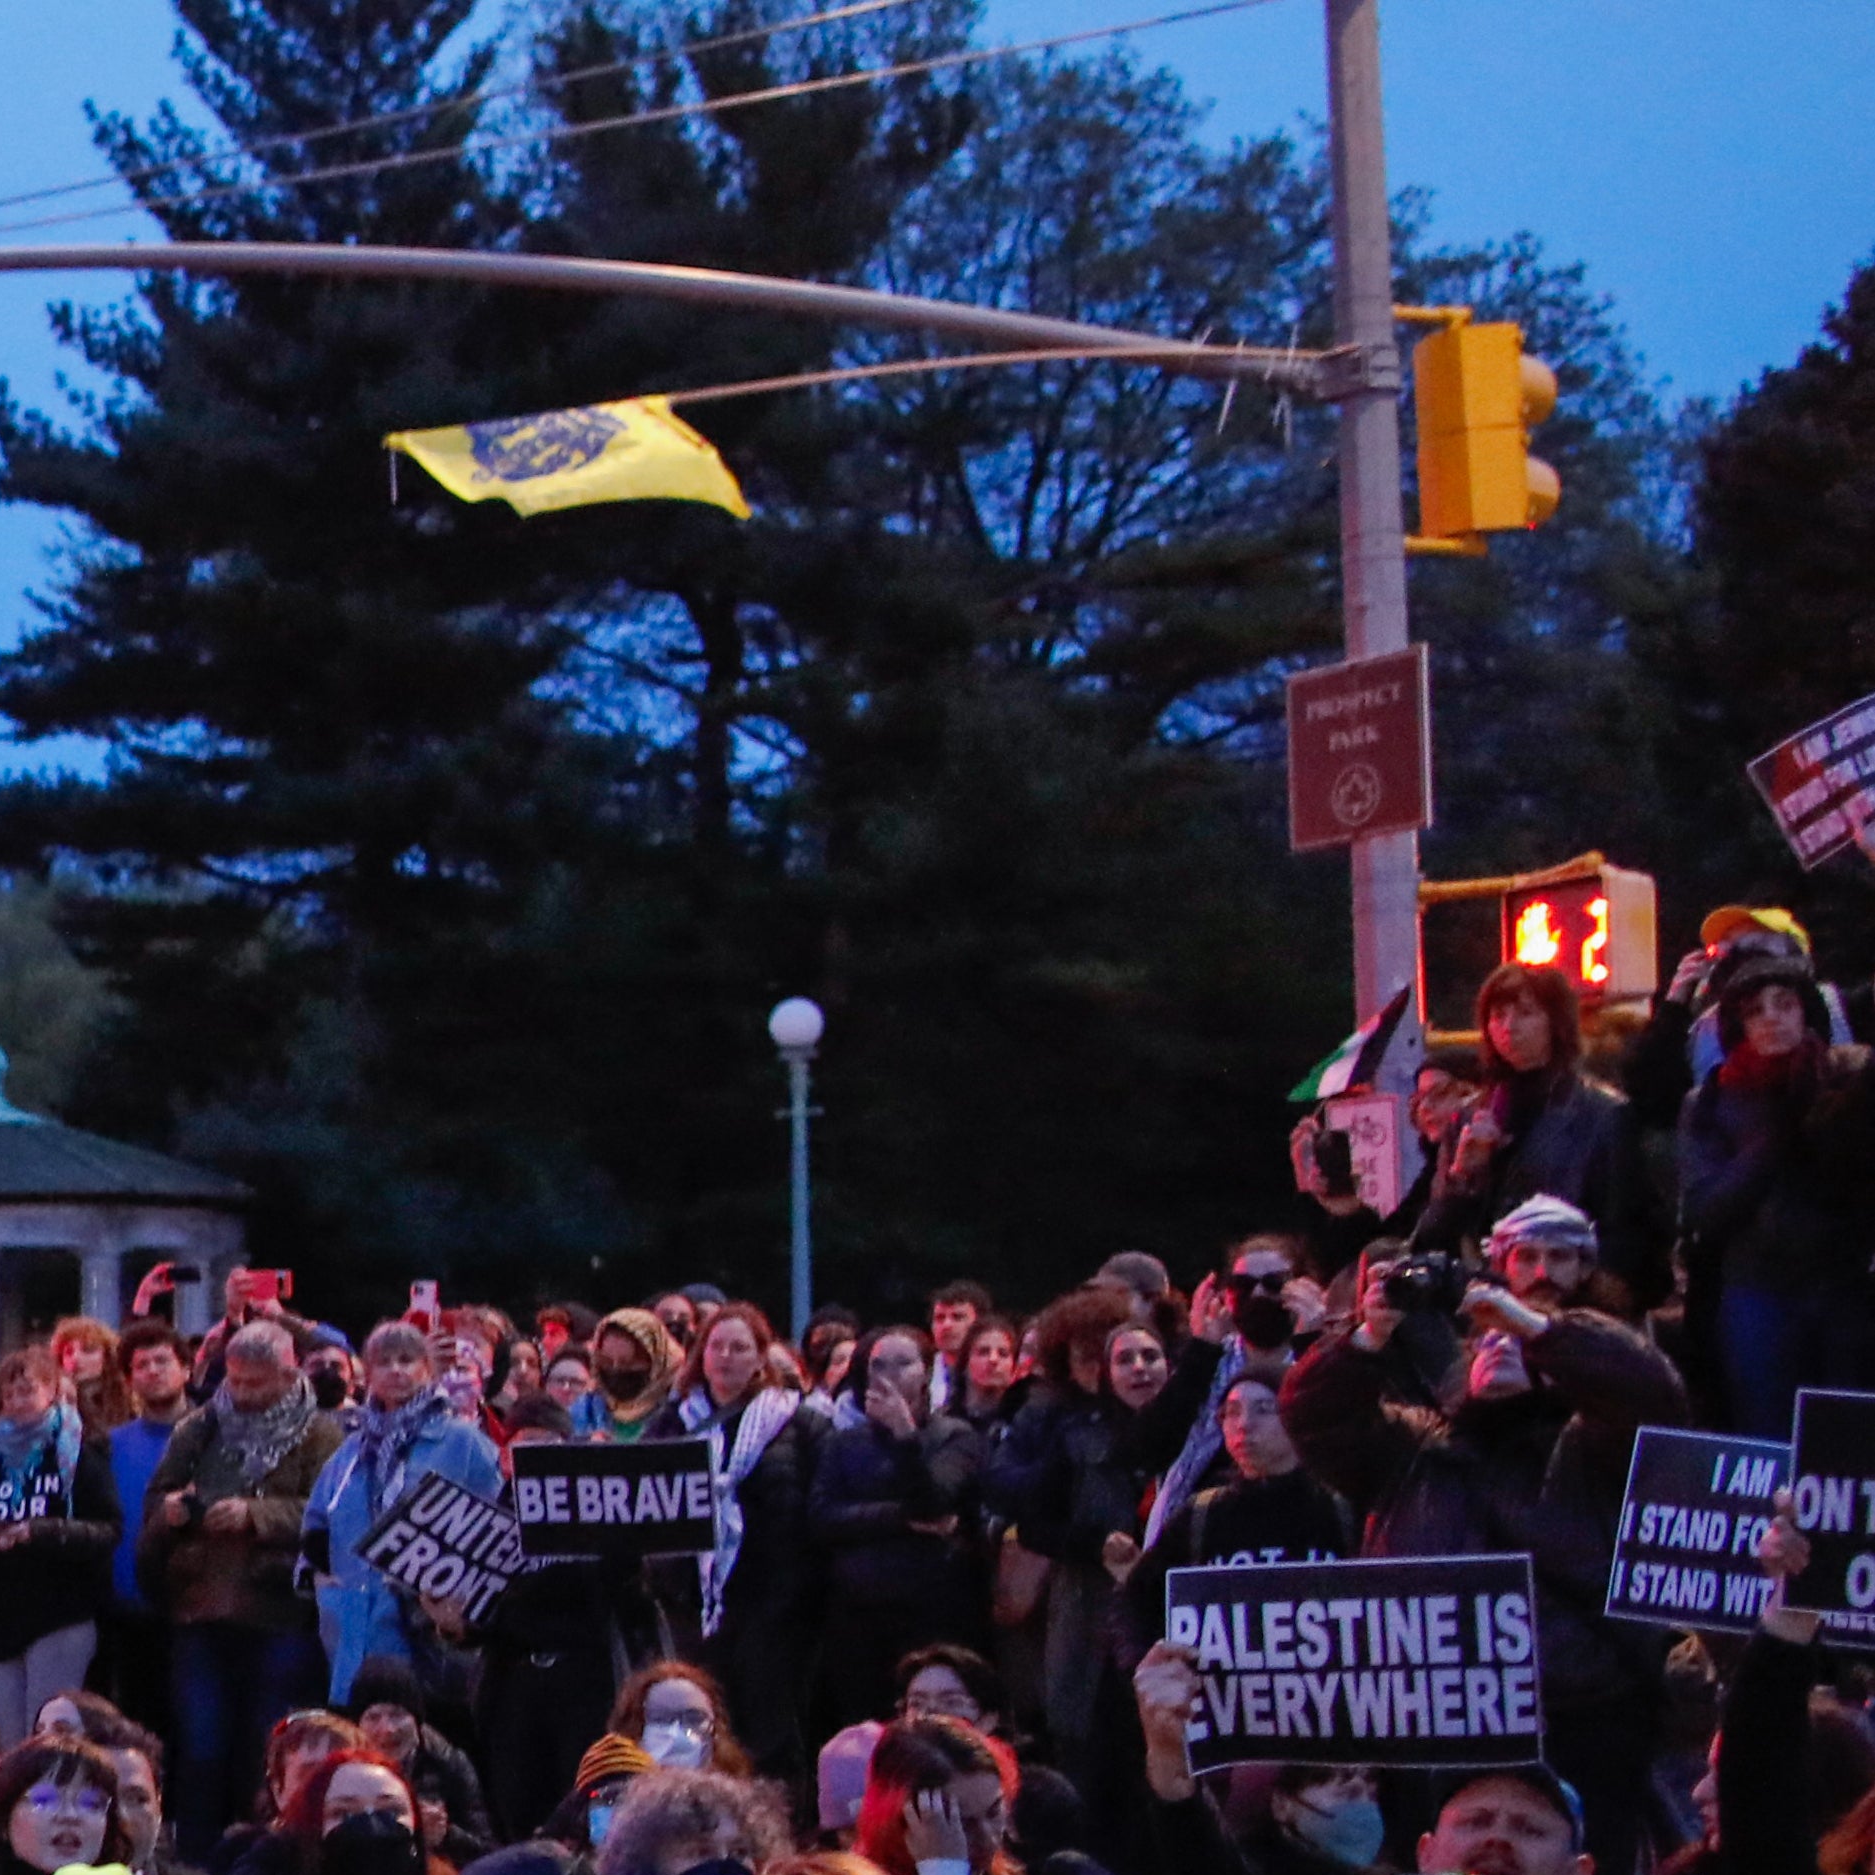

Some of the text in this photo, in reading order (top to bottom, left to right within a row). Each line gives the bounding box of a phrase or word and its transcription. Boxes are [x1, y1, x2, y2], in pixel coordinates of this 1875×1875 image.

[517, 1471, 712, 1524] BE BRAVE
[1710, 1453, 1777, 1499] I AM
[1621, 1501, 1772, 1559] I STAND FO
[365, 1519, 507, 1623] FRONT
[1611, 1559, 1776, 1618] I STAND WIT
[1170, 1593, 1532, 1671] PALESTINE IS
[1184, 1667, 1538, 1744] EVERYWHERE
